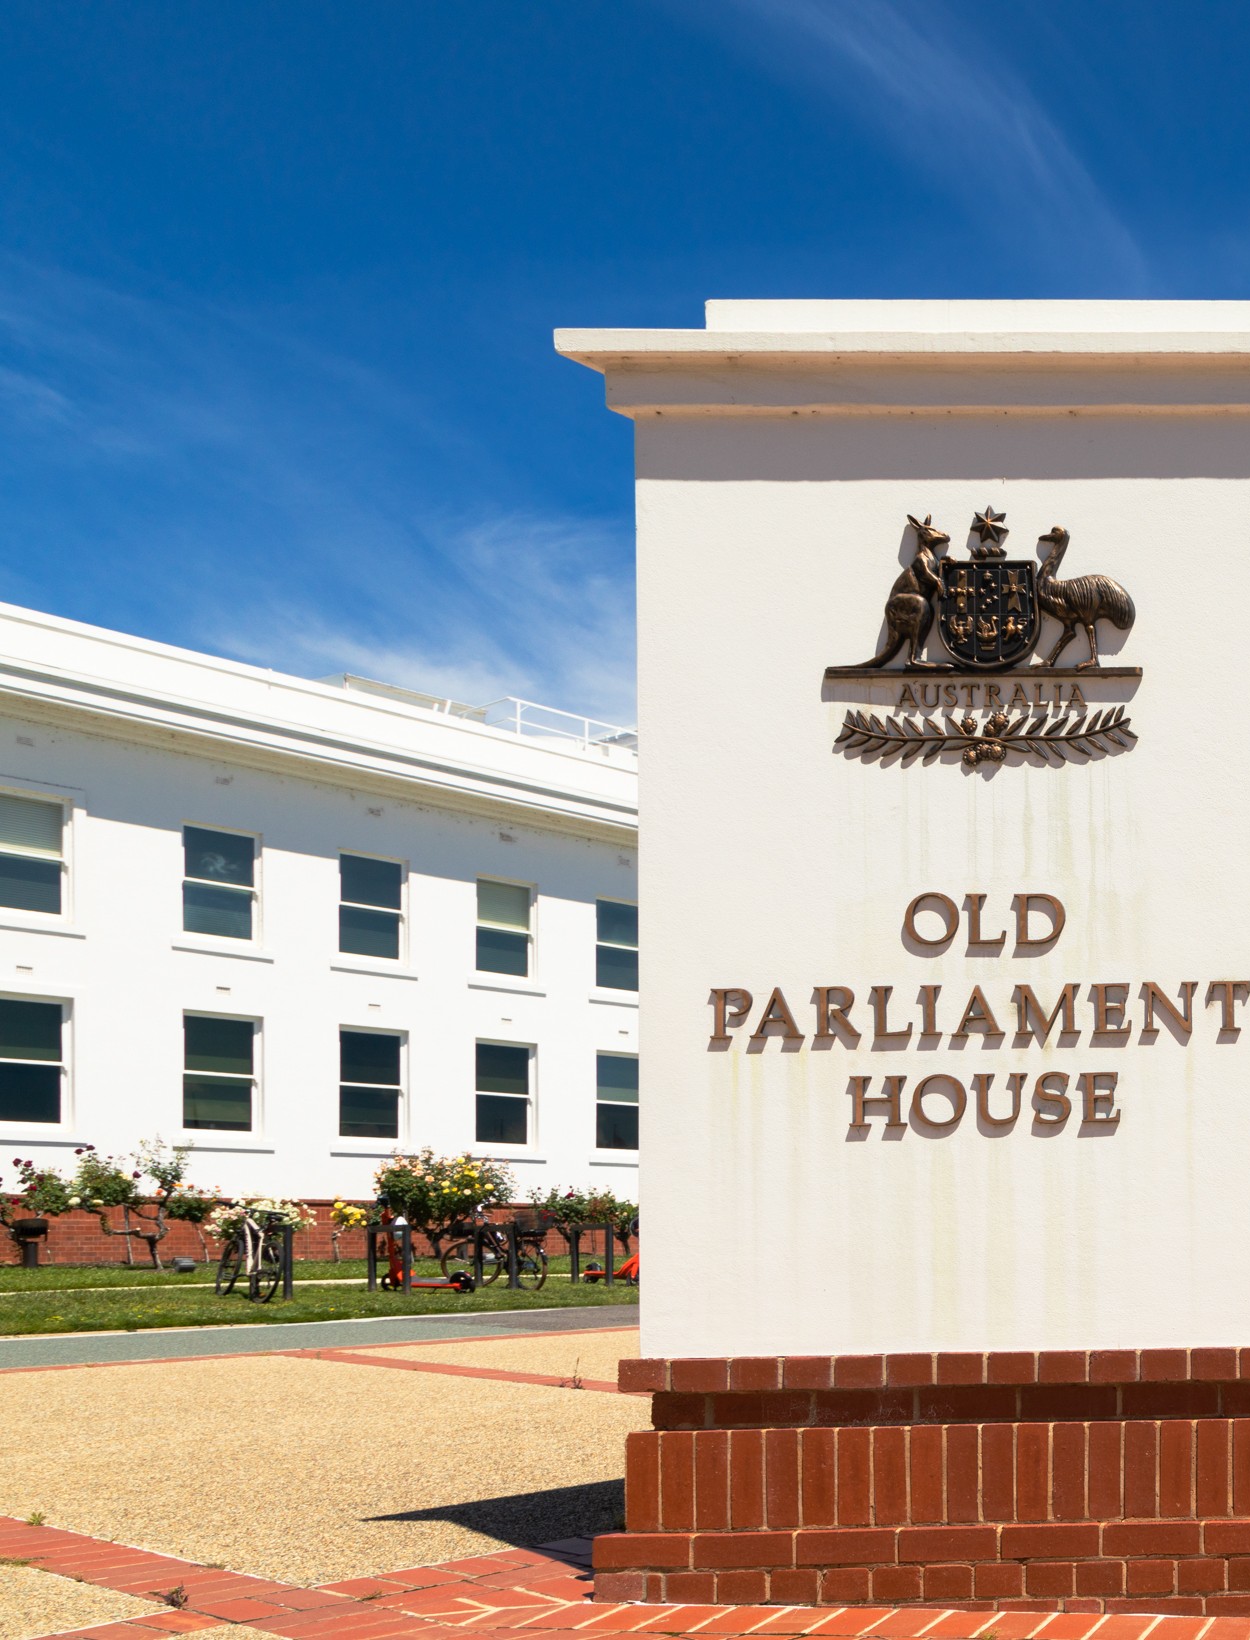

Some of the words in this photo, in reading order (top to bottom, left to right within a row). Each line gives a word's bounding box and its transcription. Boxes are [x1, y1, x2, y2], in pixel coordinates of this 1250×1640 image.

[897, 682, 1089, 709] AUSTRALIA
[903, 891, 1066, 945] OLD
[709, 980, 1250, 1038] PARLIAMENT
[848, 1071, 1121, 1128] HOUSE
